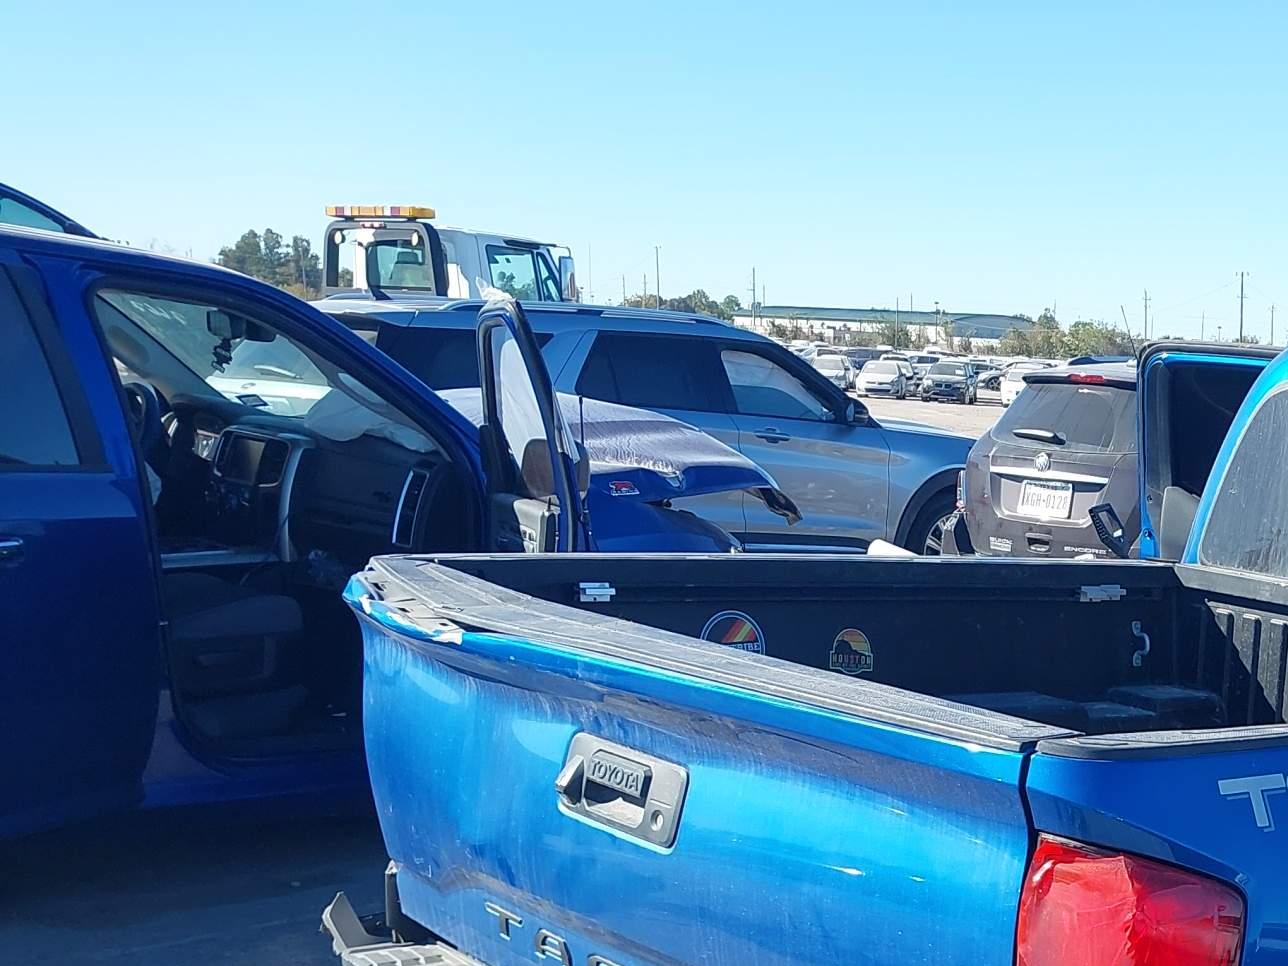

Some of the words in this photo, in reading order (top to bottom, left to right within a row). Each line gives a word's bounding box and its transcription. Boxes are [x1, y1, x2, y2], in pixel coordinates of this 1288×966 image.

[1063, 546, 1107, 554] ENCORE
[832, 653, 871, 665] HOUSTON
[591, 760, 640, 792] TOYOTA
